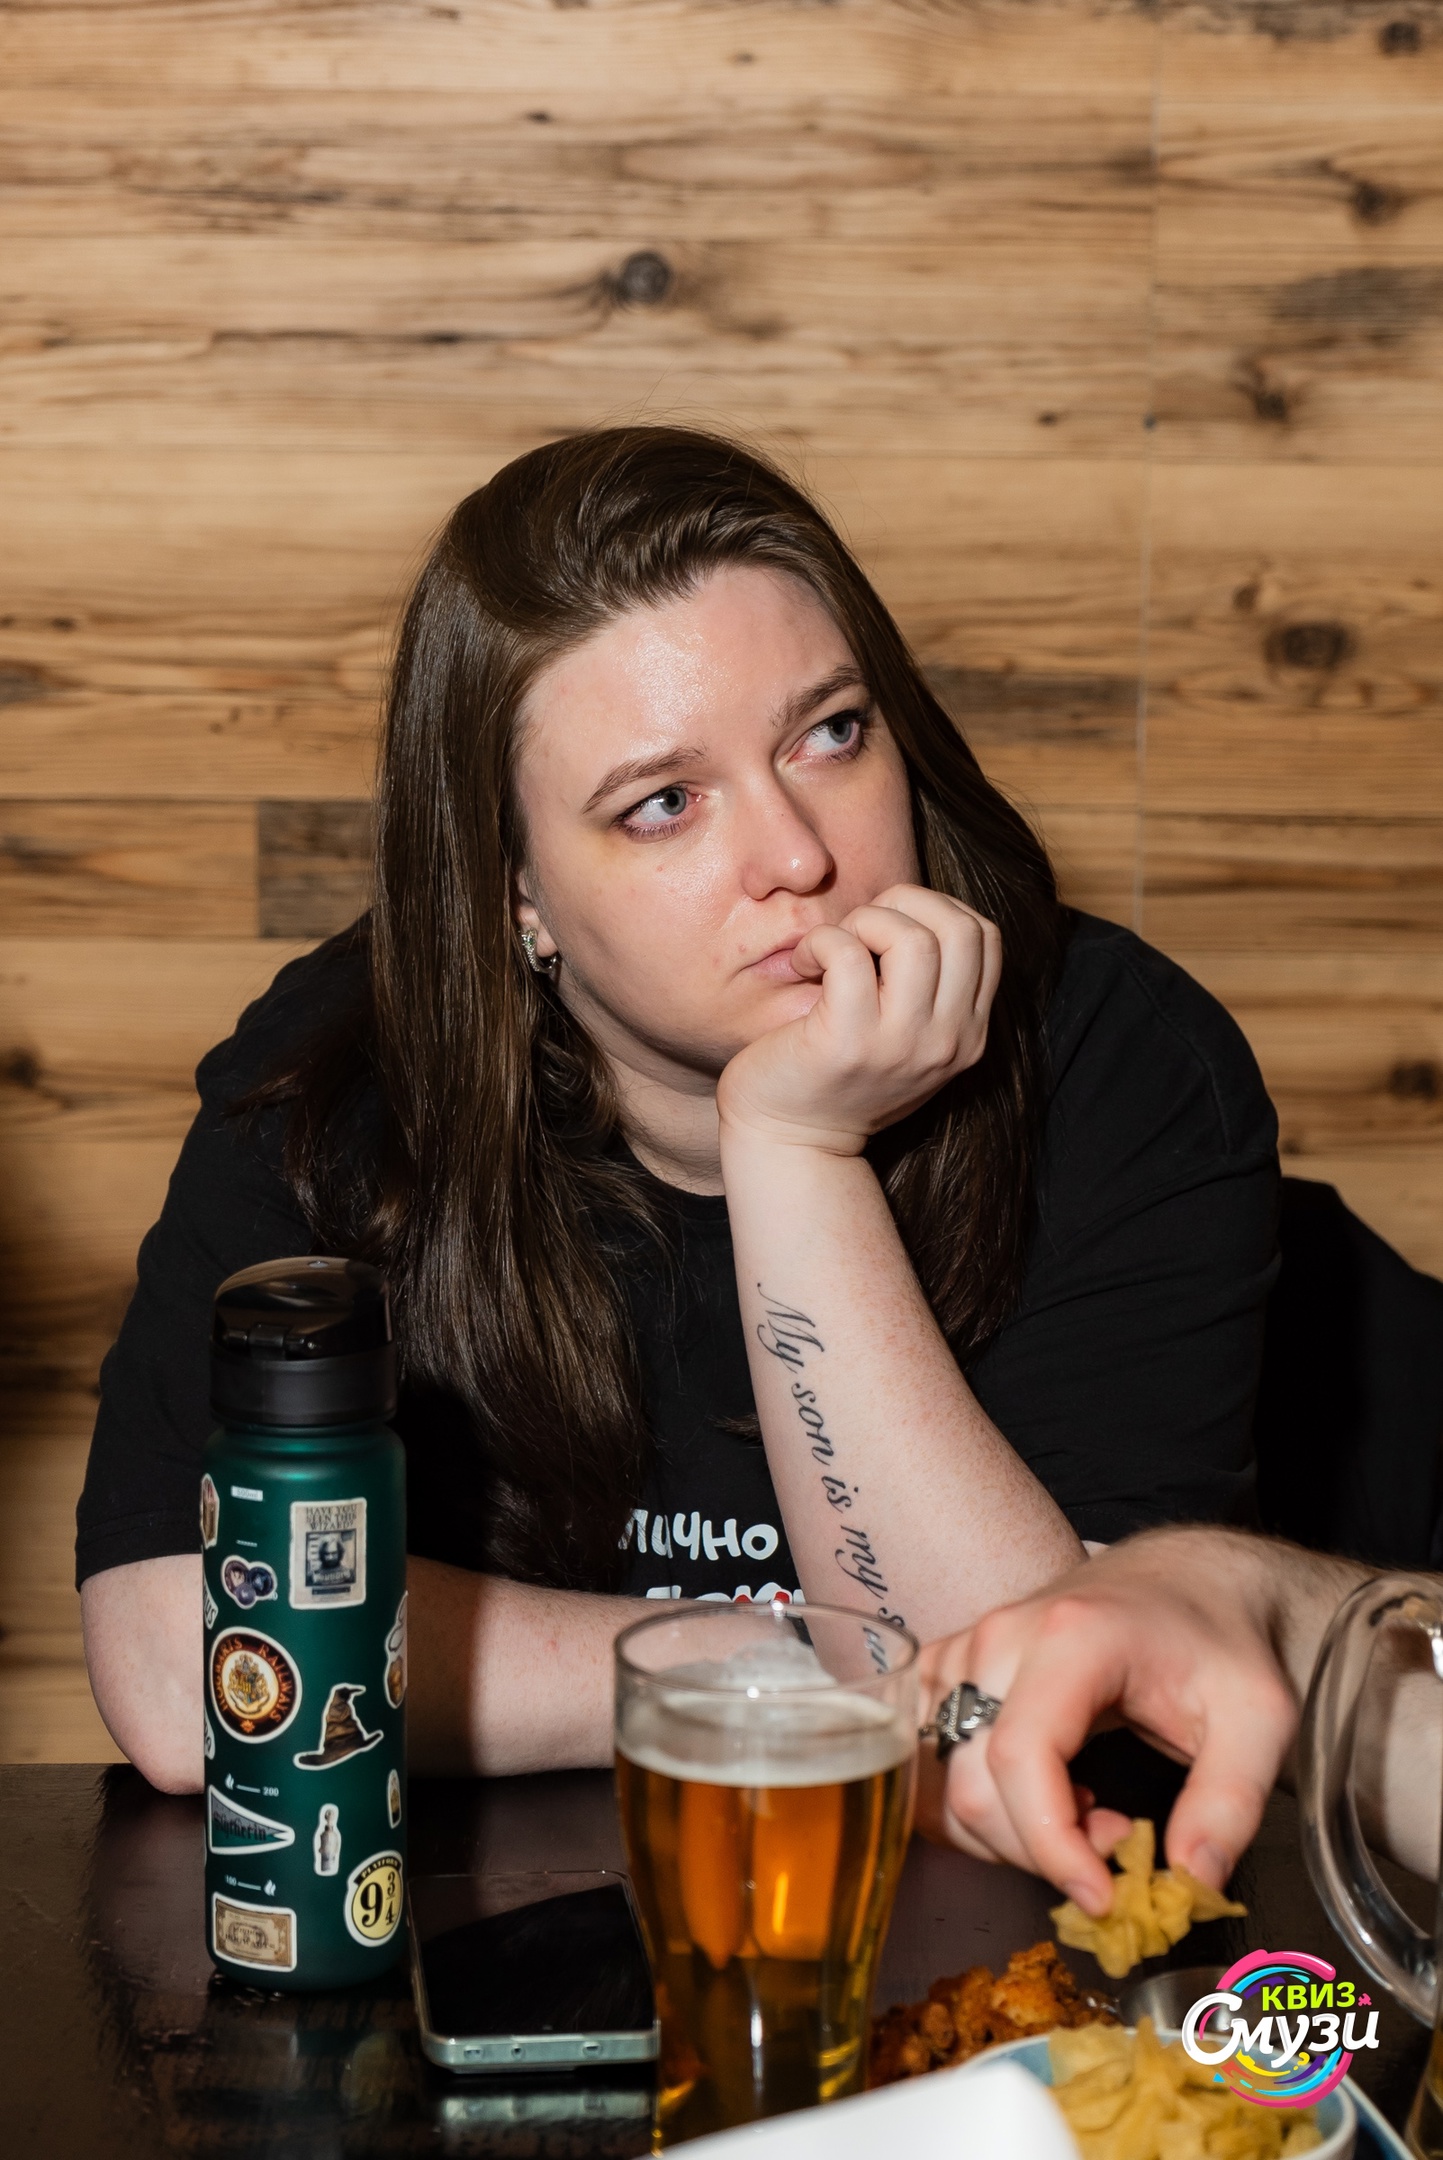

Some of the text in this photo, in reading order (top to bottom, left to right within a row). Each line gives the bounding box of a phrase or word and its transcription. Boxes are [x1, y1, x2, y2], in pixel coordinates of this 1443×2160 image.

[756, 1282, 825, 1374] My
[791, 1381, 836, 1467] son
[306, 1504, 358, 1515] HAVE YOU
[820, 1474, 860, 1515] is
[834, 1524, 889, 1601] my
[263, 1786, 280, 1797] 200
[225, 1874, 237, 1887] 100
